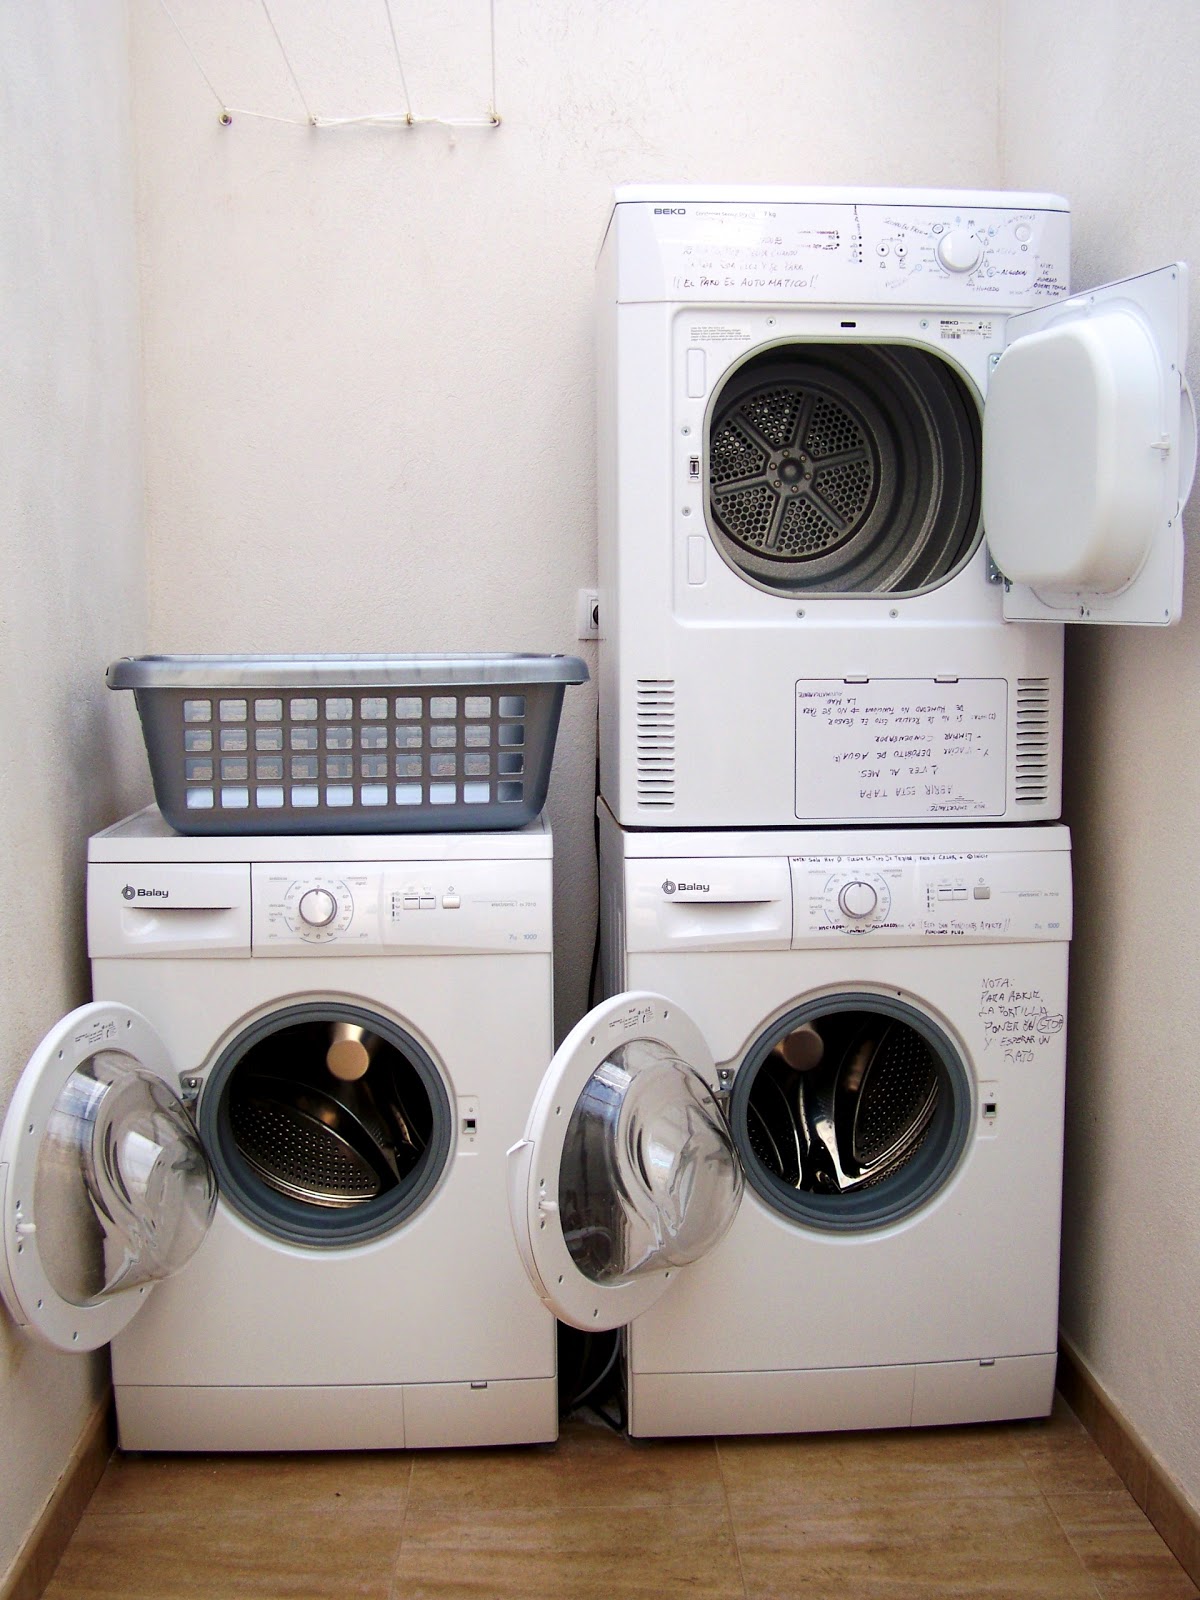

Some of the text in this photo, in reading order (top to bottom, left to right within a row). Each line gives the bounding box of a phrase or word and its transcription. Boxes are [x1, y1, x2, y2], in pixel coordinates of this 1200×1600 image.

[683, 279, 695, 288] EL
[700, 276, 720, 287] PARO
[724, 277, 735, 286] ES
[847, 697, 856, 706] LA
[802, 707, 817, 718] PARA
[821, 707, 832, 716] SE
[956, 704, 964, 712] DE
[827, 718, 854, 728] SENSOR
[874, 734, 934, 743] CONDENSADOR
[876, 751, 887, 760] DE
[890, 768, 900, 776] AL
[908, 766, 927, 774] VEZ
[859, 785, 953, 799] ABRIR ESTA TAPA
[137, 888, 169, 899] Balay
[677, 883, 710, 893] Balay
[982, 978, 1015, 989] NOTA:
[980, 990, 1040, 1003] PARA ABRIR
[978, 1005, 1047, 1018] LA PORTILLA
[984, 1021, 1019, 1034] PONER
[1000, 1035, 1035, 1046] ESPERAR
[1039, 1035, 1050, 1045] UN
[1004, 1048, 1034, 1063] RATO
